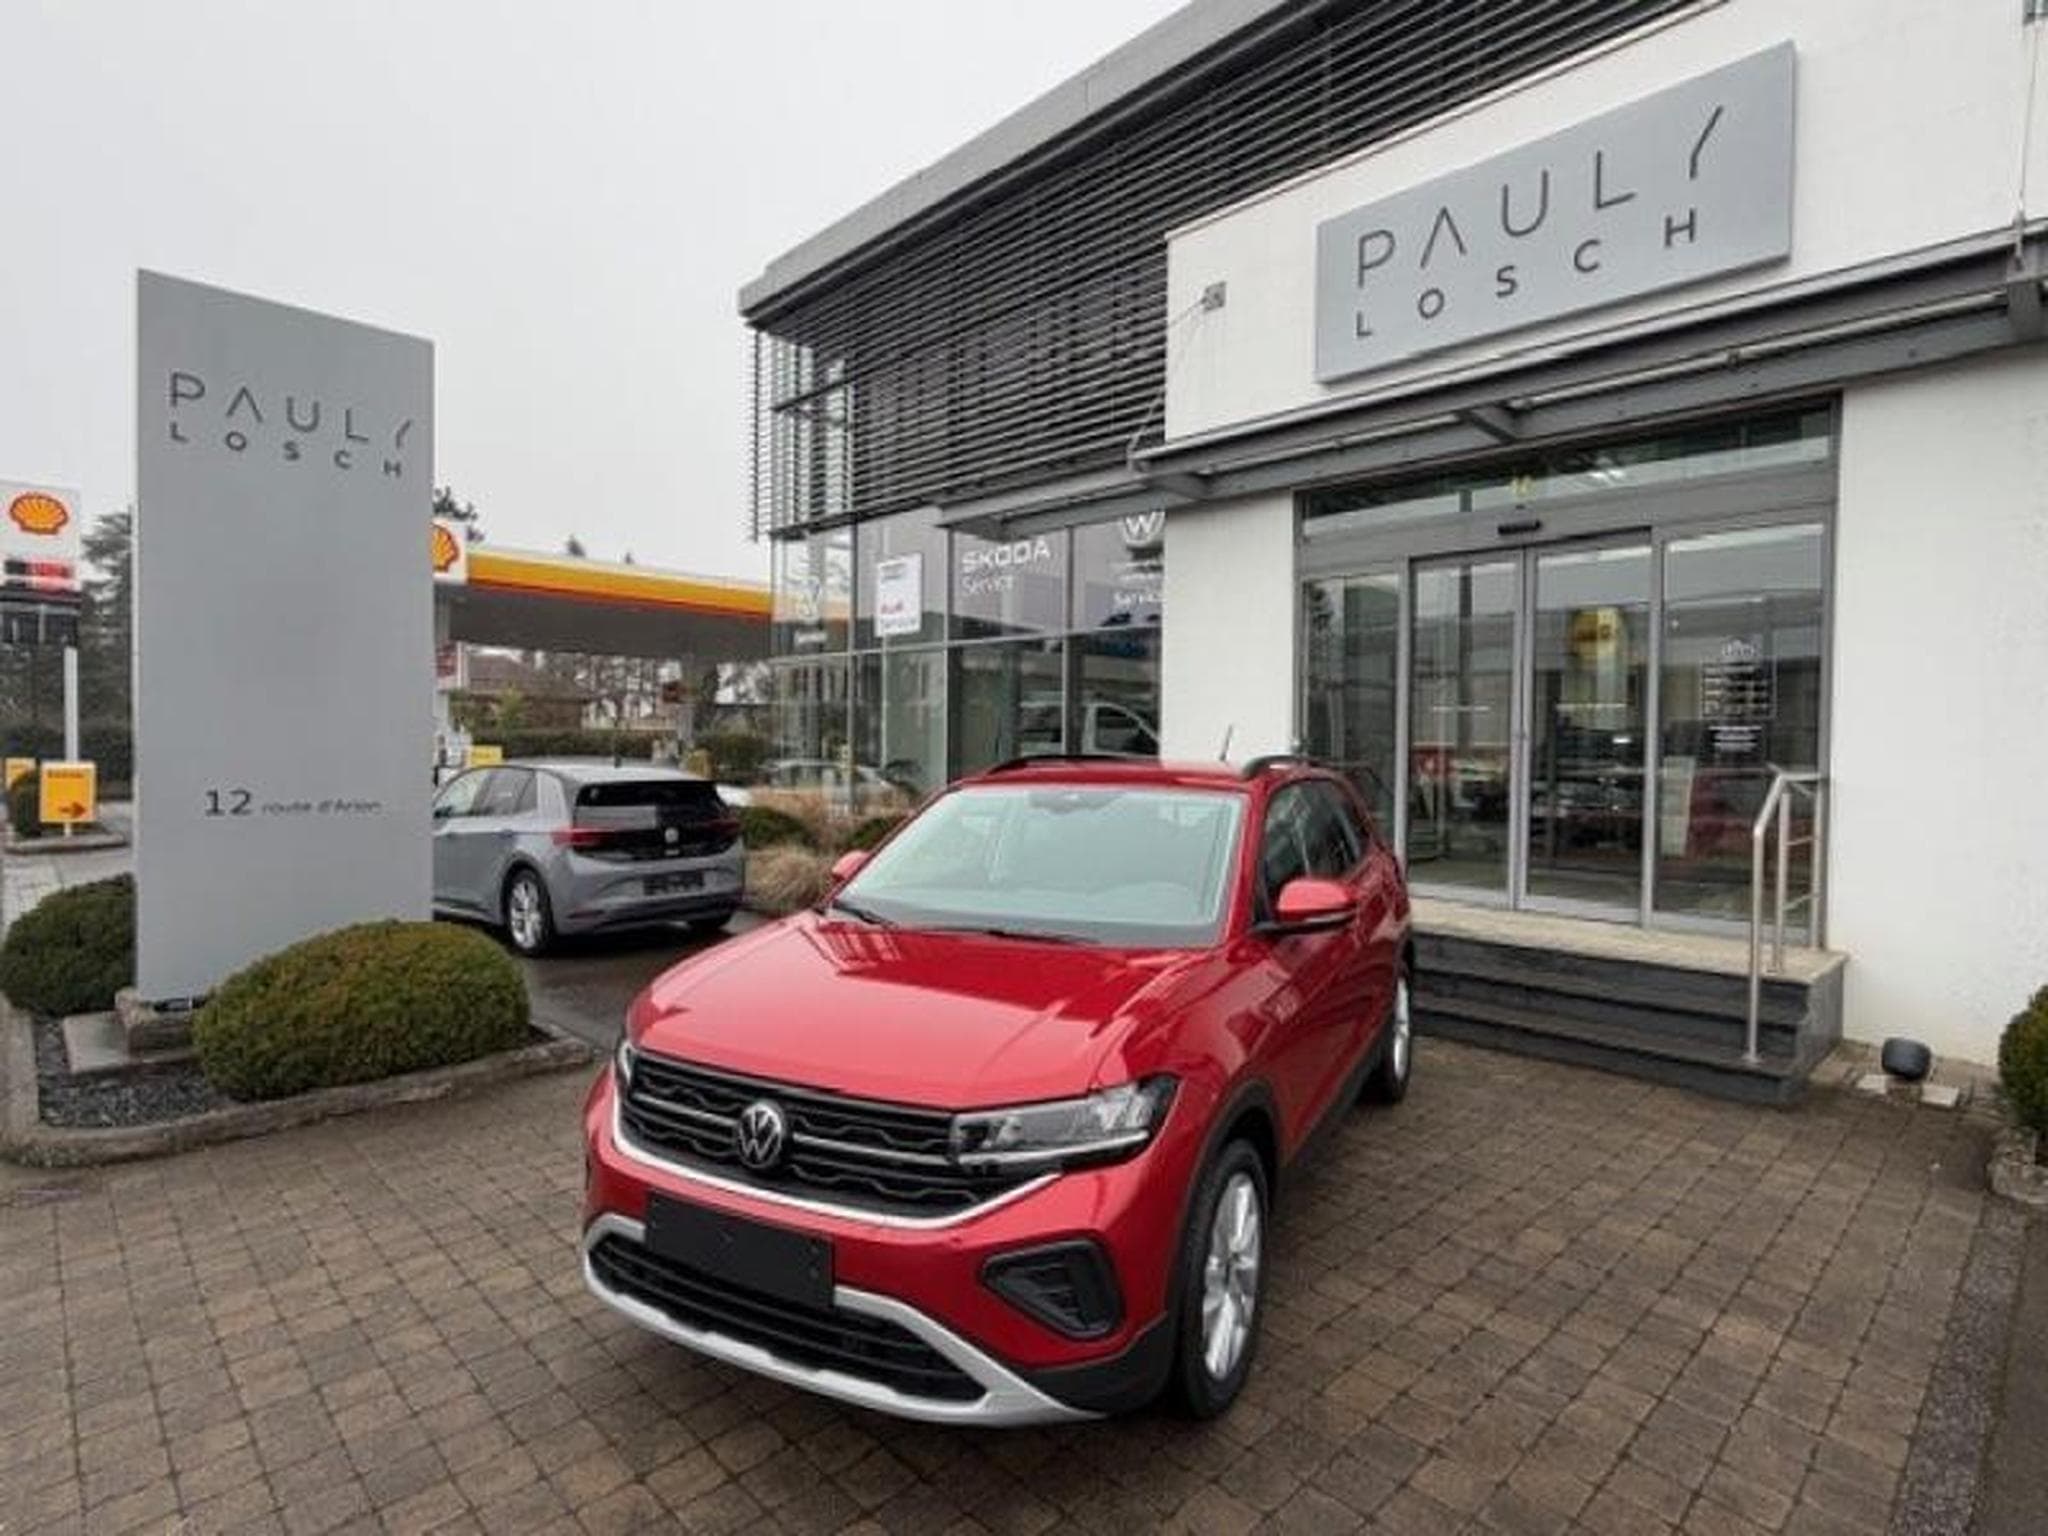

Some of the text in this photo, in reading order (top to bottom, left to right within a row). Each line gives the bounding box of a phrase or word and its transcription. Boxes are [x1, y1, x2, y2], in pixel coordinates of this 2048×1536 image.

[1357, 105, 1724, 289] PAULY
[1356, 207, 1697, 338] LOSCH
[168, 421, 402, 479] LOSCH
[169, 371, 413, 451] PAULY
[204, 789, 254, 816] 12
